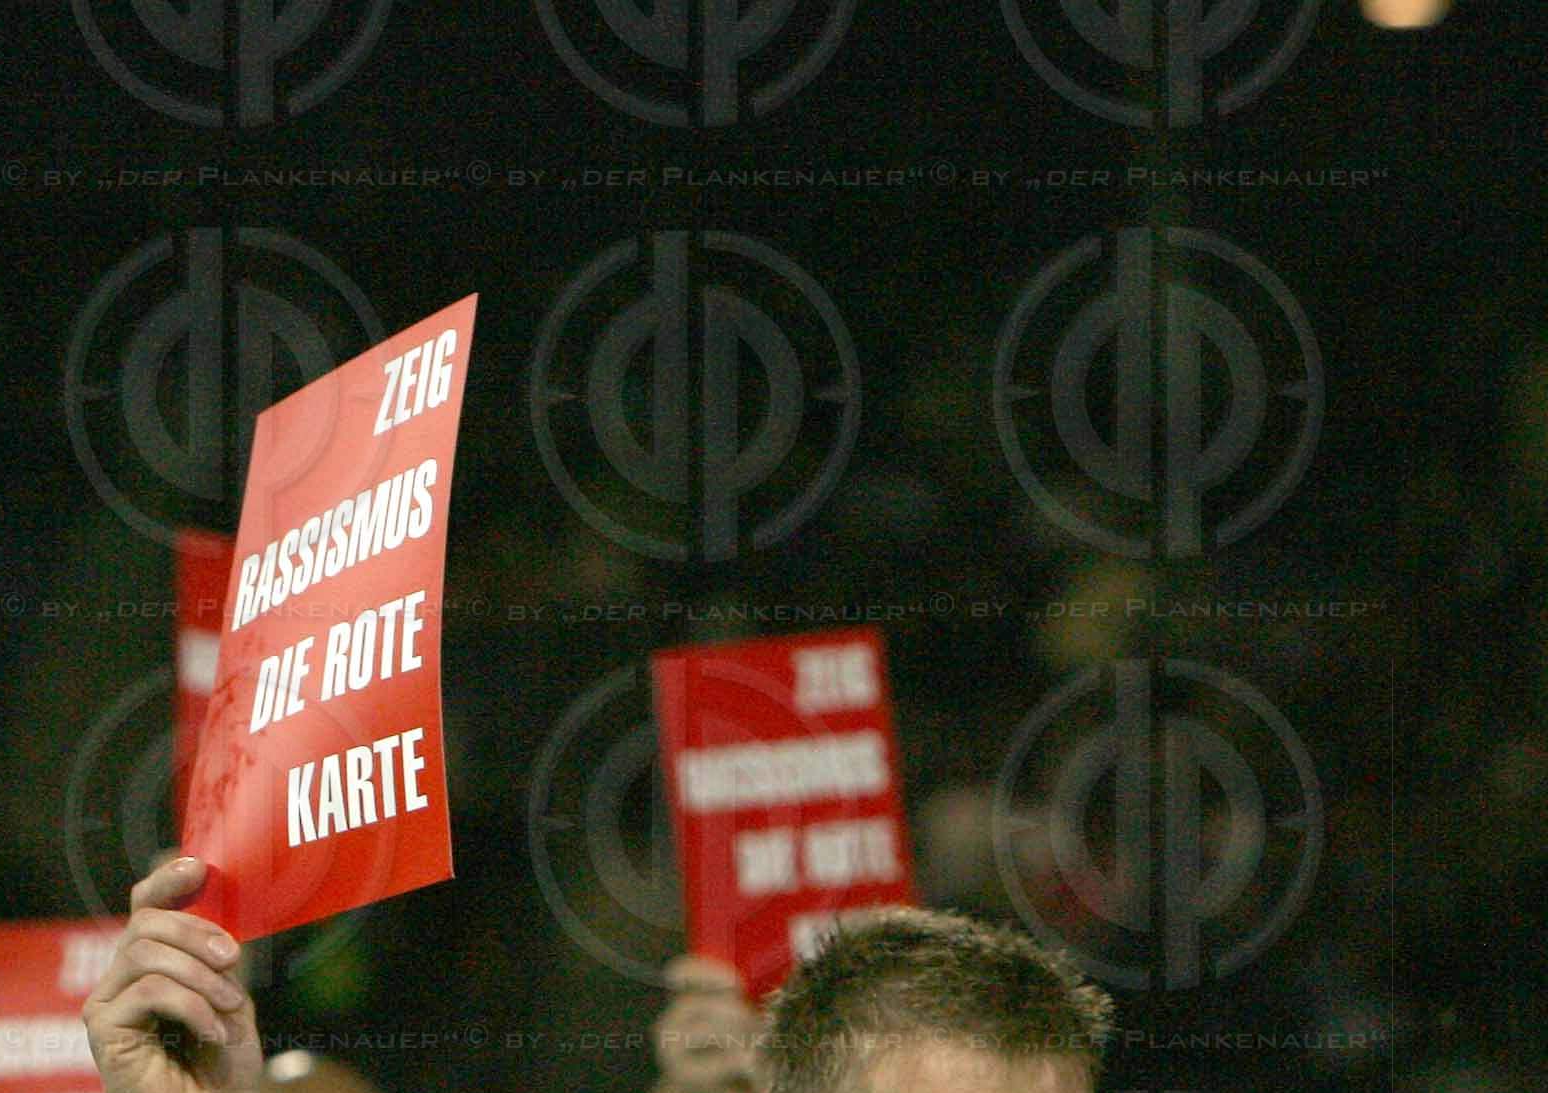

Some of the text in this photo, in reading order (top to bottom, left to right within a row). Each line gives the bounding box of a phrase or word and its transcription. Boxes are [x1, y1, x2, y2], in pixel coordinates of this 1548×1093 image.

[373, 328, 457, 436] ZEIG
[230, 457, 438, 632] RASSISMUS
[249, 636, 314, 734] DIE
[321, 590, 426, 702] ROTE
[286, 727, 428, 848] KARTE
